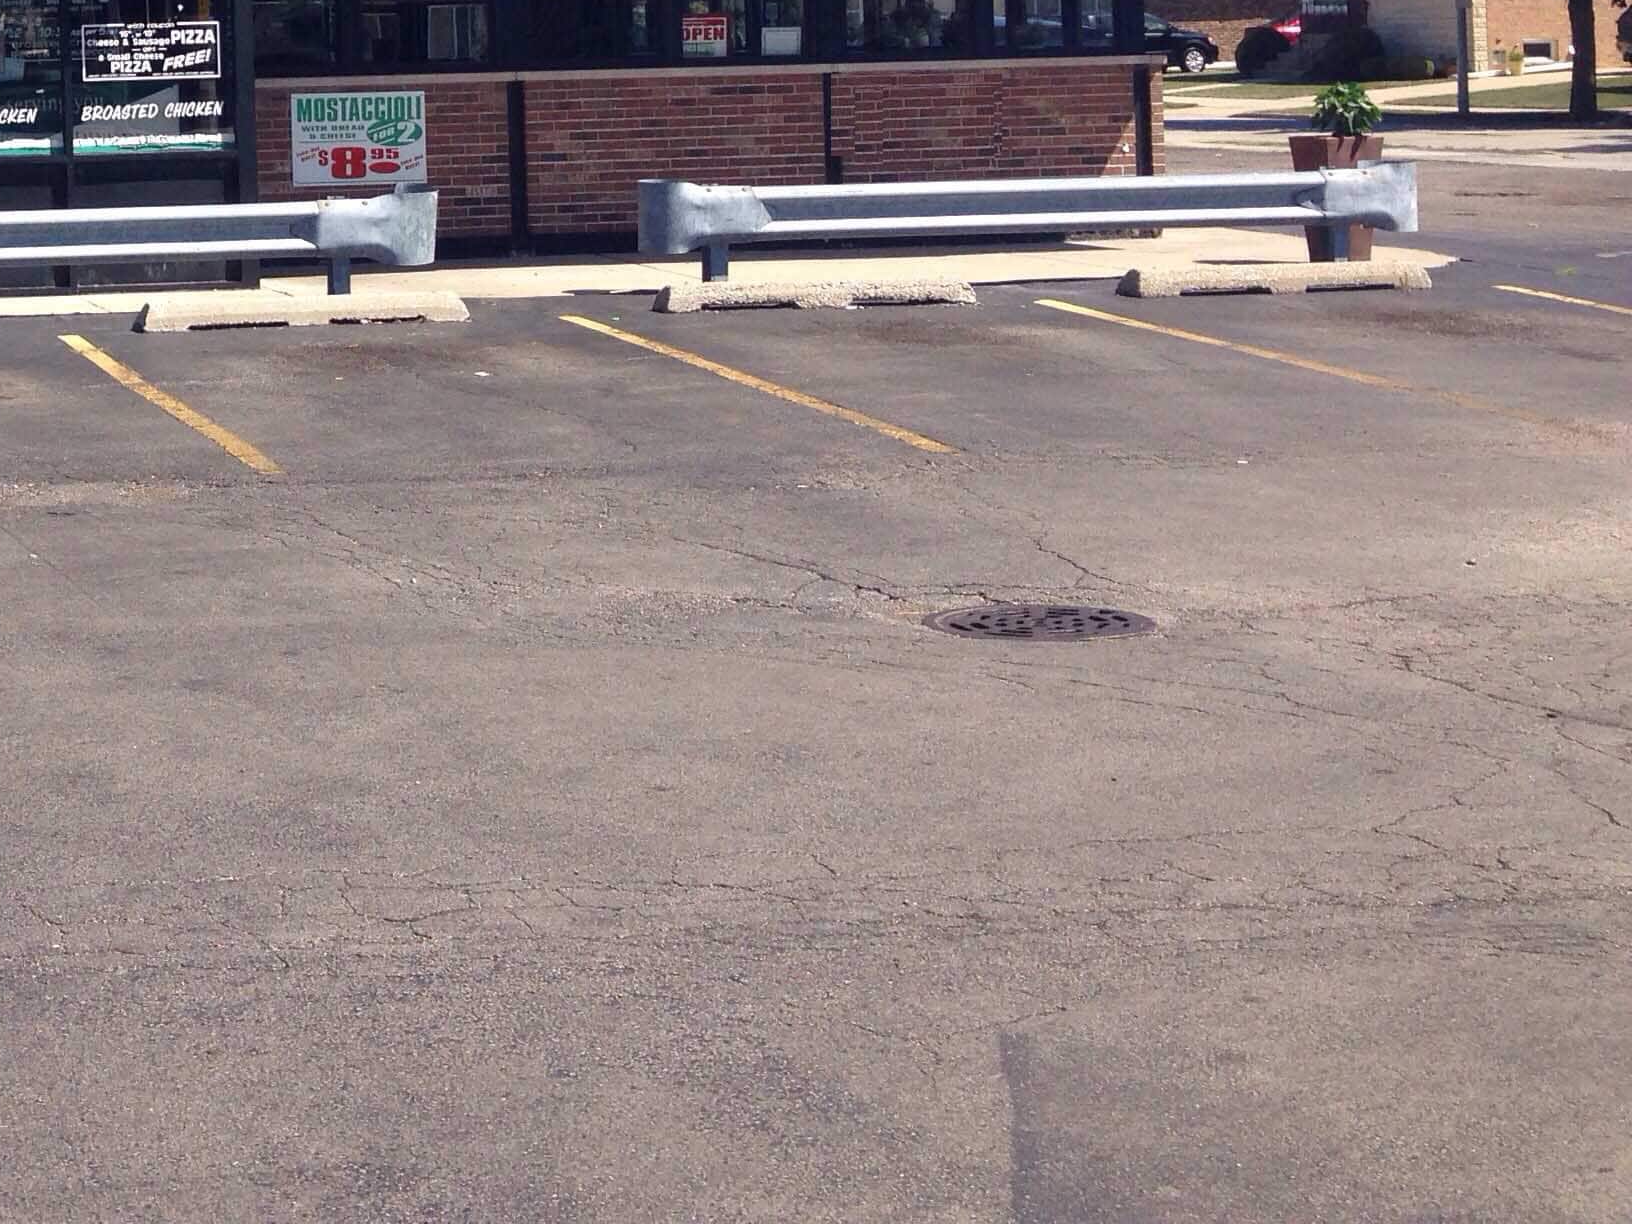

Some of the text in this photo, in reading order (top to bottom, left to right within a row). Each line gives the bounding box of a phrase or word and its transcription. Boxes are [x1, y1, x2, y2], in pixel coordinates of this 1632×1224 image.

[170, 29, 216, 44] PIZZA
[110, 48, 212, 73] PIZZA FREE!
[80, 100, 224, 122] BROASTED CHICKEN
[296, 96, 421, 123] MOSTACCIOLI
[396, 121, 416, 143] 2
